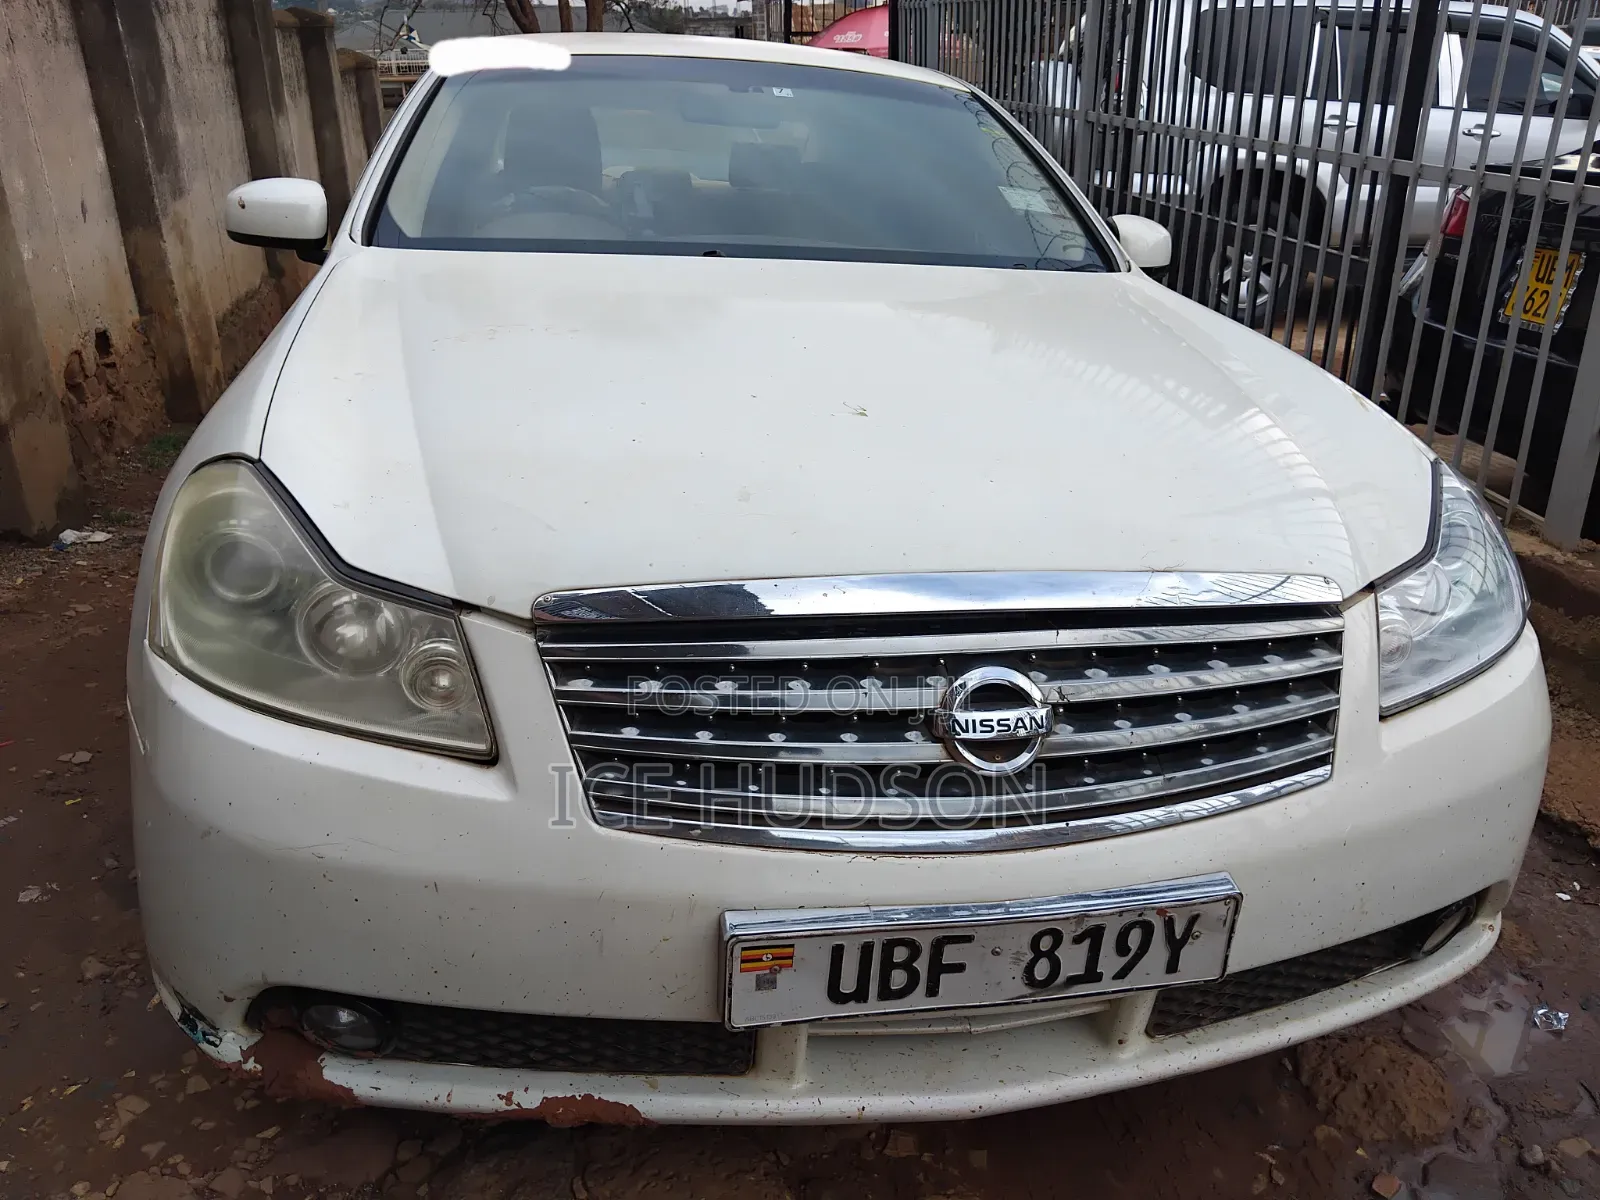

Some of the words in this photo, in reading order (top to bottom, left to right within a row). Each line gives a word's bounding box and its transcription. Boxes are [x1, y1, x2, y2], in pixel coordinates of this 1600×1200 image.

[951, 715, 1045, 736] NISSAN
[826, 934, 976, 1005] UBF
[1023, 913, 1201, 990] 819Y
